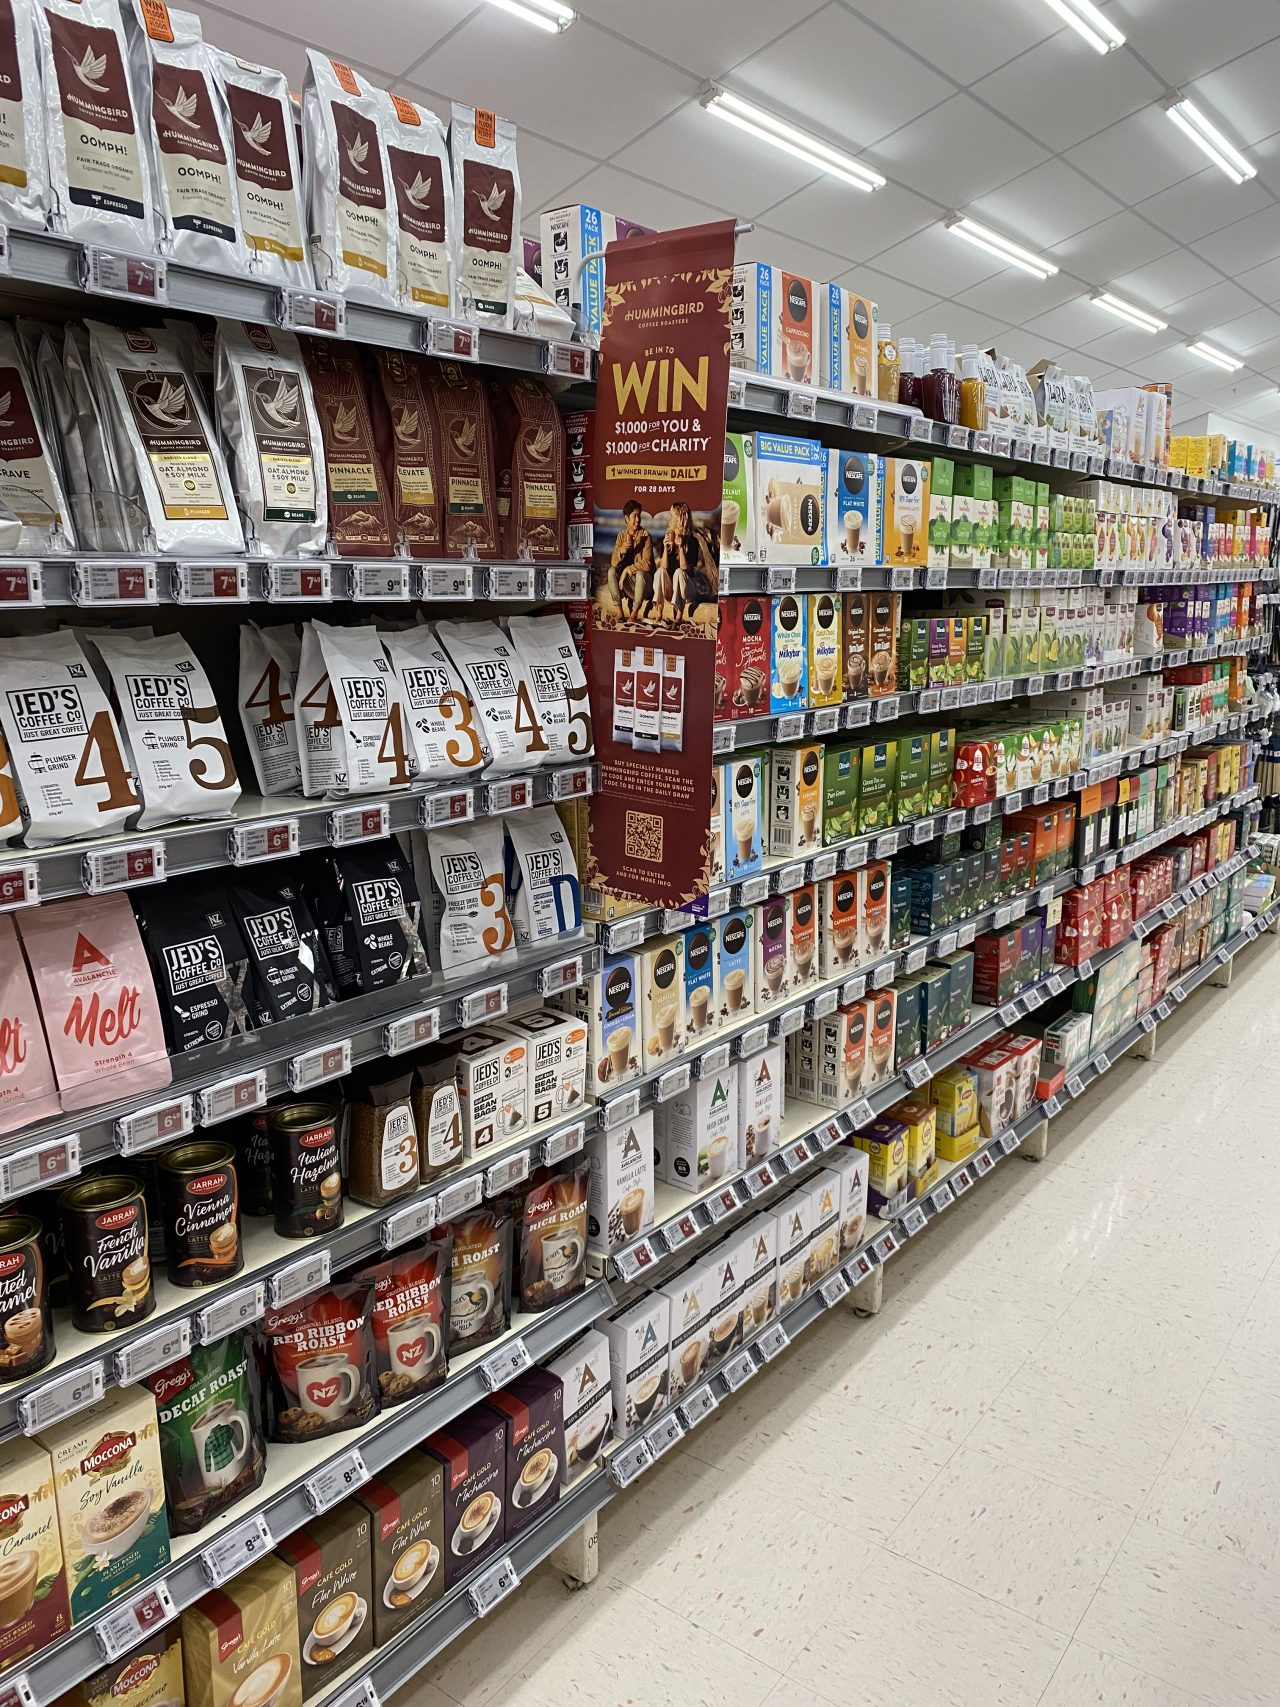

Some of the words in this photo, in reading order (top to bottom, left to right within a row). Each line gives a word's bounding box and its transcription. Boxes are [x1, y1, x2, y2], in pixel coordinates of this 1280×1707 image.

[66, 92, 128, 118] HUMMINGBIRD
[478, 110, 493, 122] WIN
[80, 134, 128, 156] OOMPH!
[163, 130, 219, 151] HUMMINGBIRD
[178, 167, 222, 184] OOMPH!
[236, 158, 286, 177] HUMMINGBIRD
[103, 198, 128, 210] ESPRESSO
[246, 192, 284, 211] OOMPH!
[345, 209, 379, 227] OOMPH!
[585, 207, 602, 225] 26
[468, 227, 509, 241] HUMMINGBIRD
[584, 223, 600, 233] PACK
[410, 244, 438, 261] OOMPH!
[472, 258, 502, 271] OOMPH!
[759, 267, 770, 280] 26
[625, 301, 704, 322] HUMMINGBIRD
[638, 321, 659, 329] COFFEE
[660, 319, 689, 327] ROASTERS
[644, 348, 653, 357] BE
[655, 346, 663, 354] IN
[665, 346, 675, 354] TO
[612, 356, 709, 416] WIN
[615, 420, 648, 435] $1,000
[649, 421, 660, 429] FOR
[661, 419, 690, 433] YOU
[693, 418, 701, 432] &
[149, 439, 201, 447] HUMMINGBIRD
[262, 440, 306, 449] HUMMINGBIRD
[605, 440, 638, 454] $1,000
[639, 441, 650, 449] FOR
[760, 440, 772, 451] BIG
[773, 442, 794, 454] VALUE
[794, 445, 811, 458] PACK
[281, 468, 310, 476] ALMOND
[329, 467, 372, 475] PINNACLE
[611, 467, 616, 477] 1
[617, 468, 642, 476] WINNER
[643, 468, 668, 476] DRAWN
[670, 466, 701, 478] DAILY
[451, 479, 479, 487] PINNACLE
[526, 483, 556, 492] PINNACLE
[778, 650, 801, 660] Milkybar
[408, 669, 448, 688] JED'S
[471, 662, 509, 681] JED'S
[534, 666, 568, 684] JED'S
[133, 677, 188, 698] JED'S
[348, 680, 385, 699] JED'S
[411, 687, 441, 699] COFFEE
[477, 681, 502, 690] COFFEE
[14, 688, 79, 717] JED'S
[136, 698, 175, 709] COFFEE
[350, 699, 376, 709] COFFEE
[19, 712, 63, 728] COFFEE
[515, 680, 550, 753] 4
[565, 684, 594, 755] 5
[23, 730, 39, 739] JUST
[40, 728, 61, 737] GREAT
[61, 725, 84, 734] COFFEE
[438, 690, 483, 767] 3
[180, 704, 238, 790] 5
[377, 702, 410, 786] 4
[45, 753, 77, 765] PLUNGER
[47, 762, 69, 772] GRIND
[74, 710, 141, 813] 4
[601, 765, 639, 776] HUMMINGBIRD
[664, 775, 681, 783] SCAN
[626, 762, 654, 771] SPECIALLY
[656, 766, 680, 776] MARKED
[604, 779, 619, 787] CODE
[643, 786, 654, 794] THE
[655, 788, 672, 797] DAILY
[673, 792, 690, 800] DRAW
[608, 772, 623, 780] CODE
[624, 775, 636, 783] AND
[637, 778, 654, 787] ENTER
[655, 780, 671, 790] YOUR
[672, 784, 695, 793] UNIQUE
[446, 853, 480, 875] JED'S
[529, 851, 560, 871] JED'S
[448, 873, 474, 885] COFFEE
[616, 870, 628, 879] AND
[628, 873, 639, 882] FOR
[640, 876, 656, 885] MORE
[657, 879, 672, 888] INFO
[622, 865, 637, 873] SCAN
[647, 871, 665, 880] ENTER
[356, 880, 400, 904] JED'S
[361, 898, 391, 913] COFFEE
[480, 872, 513, 957] 3
[250, 910, 293, 938] JED'S
[169, 939, 220, 971] JED'S
[73, 968, 118, 985] AVALANCHE
[172, 964, 207, 982] COFFEE
[189, 999, 218, 1013] ESPRESSO
[64, 985, 141, 1047] Melt
[183, 1035, 205, 1050] EXTREME
[94, 1054, 126, 1067] Strength
[94, 1062, 117, 1074] Whole
[534, 1076, 558, 1089] BEAN
[534, 1082, 557, 1096] BAGS
[474, 1097, 498, 1114] BEAN
[474, 1105, 498, 1121] BAGS
[304, 1129, 332, 1143] JARRAH
[297, 1144, 336, 1167] Italian
[191, 1176, 224, 1190] JARRAH
[183, 1193, 230, 1220] Vienna
[101, 1208, 135, 1225] JARRAH
[175, 1202, 236, 1237] Cinnamon
[528, 1216, 557, 1233] RICH
[97, 1220, 139, 1254] French
[84, 1236, 145, 1278] Vanilla
[396, 1274, 442, 1303] RIBBON
[388, 1293, 430, 1319] ROAST
[268, 1310, 304, 1331] Gregg's
[272, 1332, 304, 1346] RED
[308, 1315, 365, 1339] RIBBON
[296, 1333, 347, 1352] ROAST
[154, 1367, 192, 1398] Gregg's
[159, 1387, 207, 1424] DECAF
[209, 1358, 248, 1395] ROAST
[312, 1384, 338, 1400] NZ
[57, 1438, 89, 1459] CREAMY
[83, 1436, 134, 1472] MOCCONA
[80, 1490, 103, 1511] Soy
[106, 1460, 144, 1494] Vanilla
[3, 1516, 52, 1556] Caramel
[356, 1522, 367, 1537] 10
[334, 1557, 353, 1576] GOLD
